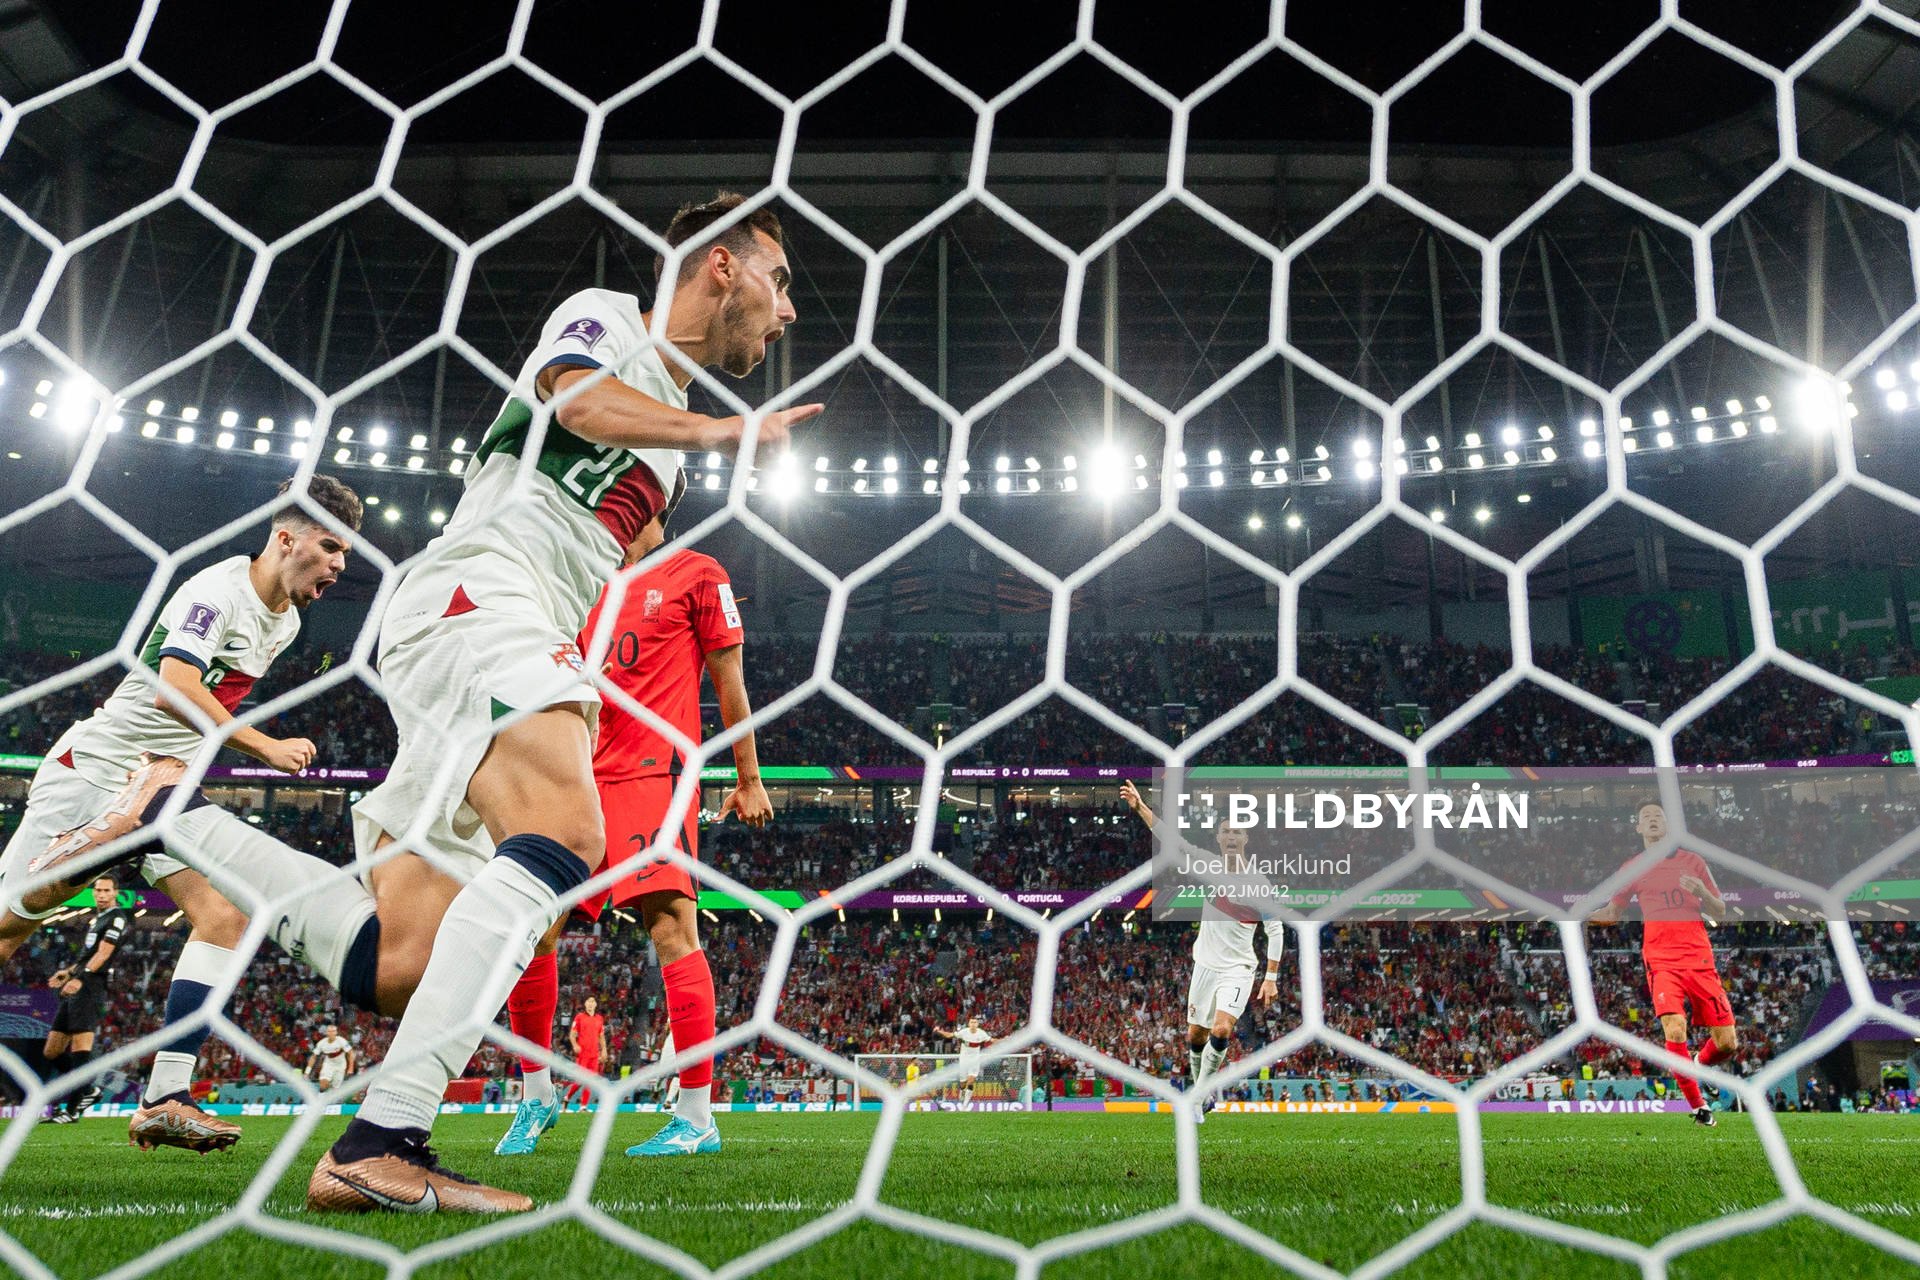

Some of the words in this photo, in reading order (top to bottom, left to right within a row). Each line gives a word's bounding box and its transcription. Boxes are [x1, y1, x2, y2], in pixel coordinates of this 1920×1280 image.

[561, 443, 636, 507] 21
[1628, 766, 1652, 774] KOREA
[1695, 763, 1704, 773] 0
[1716, 763, 1725, 773] 0
[1729, 763, 1767, 772] PORTUGAL
[1797, 760, 1817, 768] 04:50
[319, 768, 328, 778] 0
[331, 769, 369, 778] PORTUGAL
[962, 768, 996, 777] REPUBLIC
[1002, 767, 1010, 777] 0
[1021, 767, 1030, 777] 0
[1033, 768, 1070, 777] PORTUGAL
[1284, 768, 1301, 777] FIFA
[1302, 768, 1331, 777] WORLD
[1331, 768, 1346, 777] CUP
[893, 894, 923, 903] KOREA
[923, 894, 967, 903] REPUBLIC
[1017, 894, 1064, 903] PORTUGAL
[1305, 894, 1330, 904] CUP
[1660, 888, 1685, 909] 10
[1233, 986, 1241, 1003] 7
